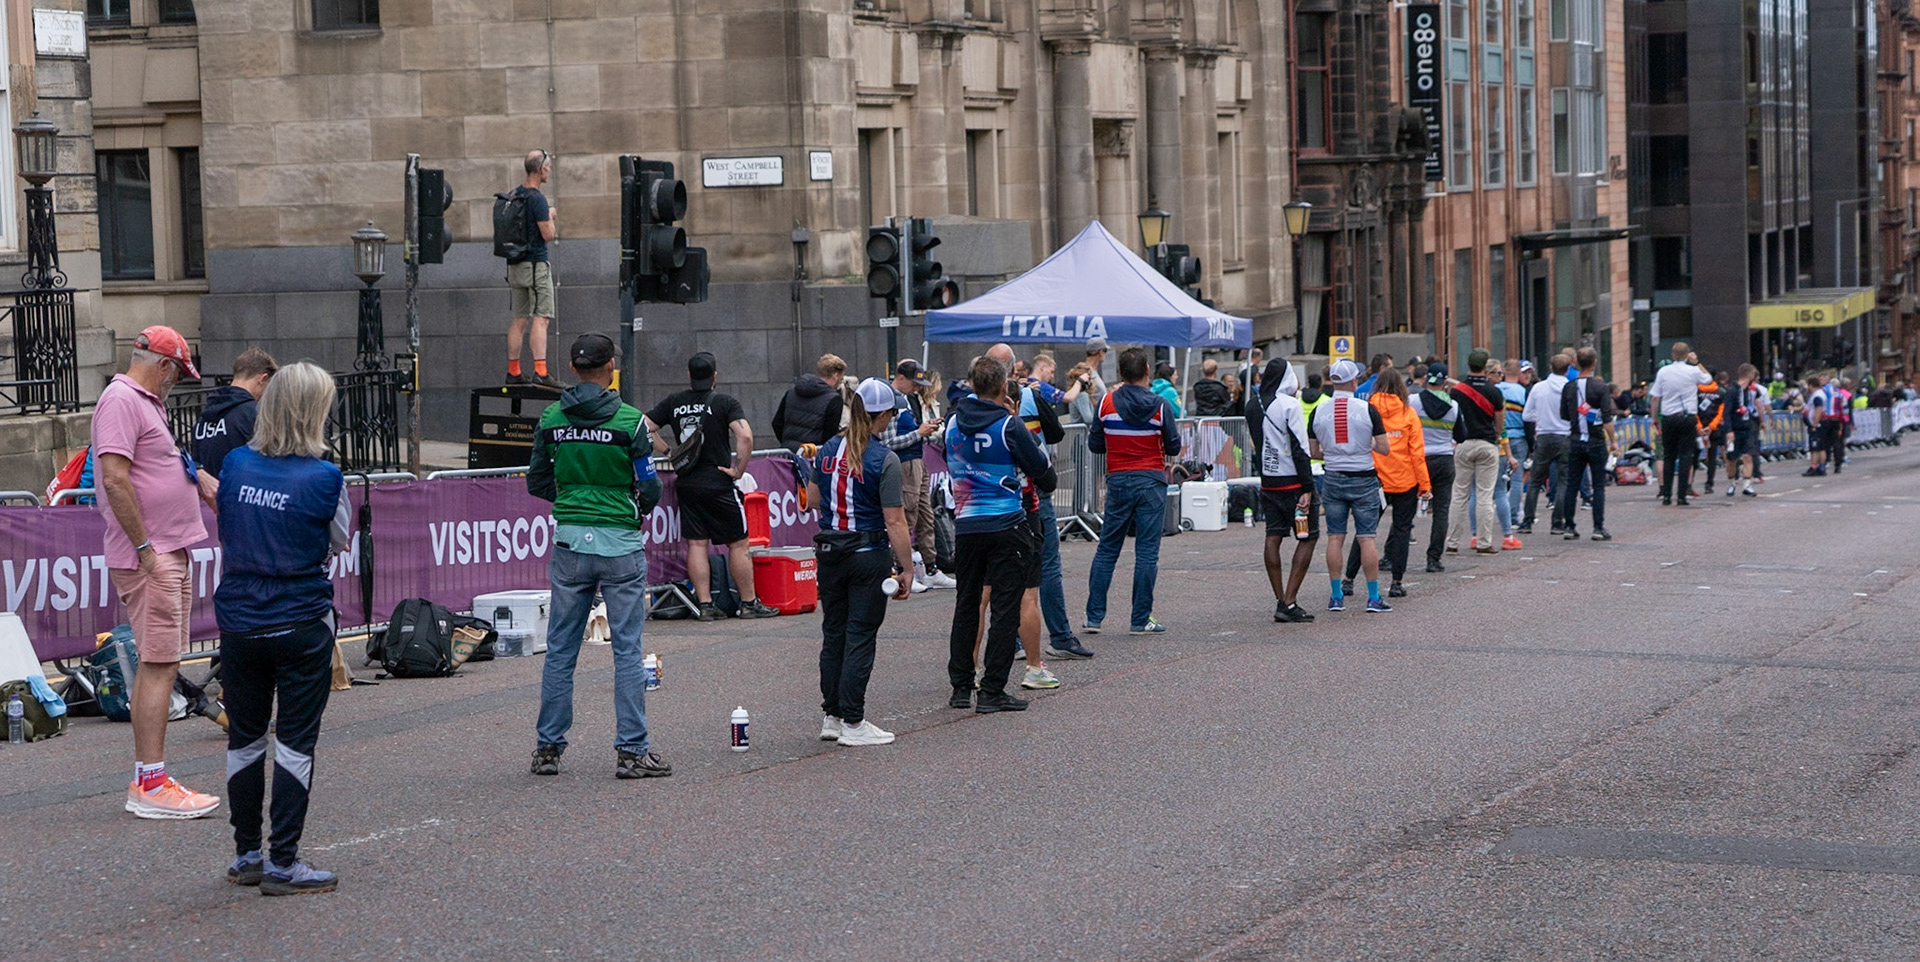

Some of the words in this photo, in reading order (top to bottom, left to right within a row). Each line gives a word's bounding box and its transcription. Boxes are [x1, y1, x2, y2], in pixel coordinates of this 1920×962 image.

[706, 162, 729, 171] WEST
[734, 160, 779, 170] CAMPBELL
[727, 171, 758, 181] STREET
[1795, 309, 1824, 322] 150
[1002, 315, 1109, 339] ITALIA
[1206, 317, 1235, 341] ITALIA
[194, 418, 228, 440] USA
[552, 428, 614, 443] IRELAND
[237, 485, 290, 511] FRANCE
